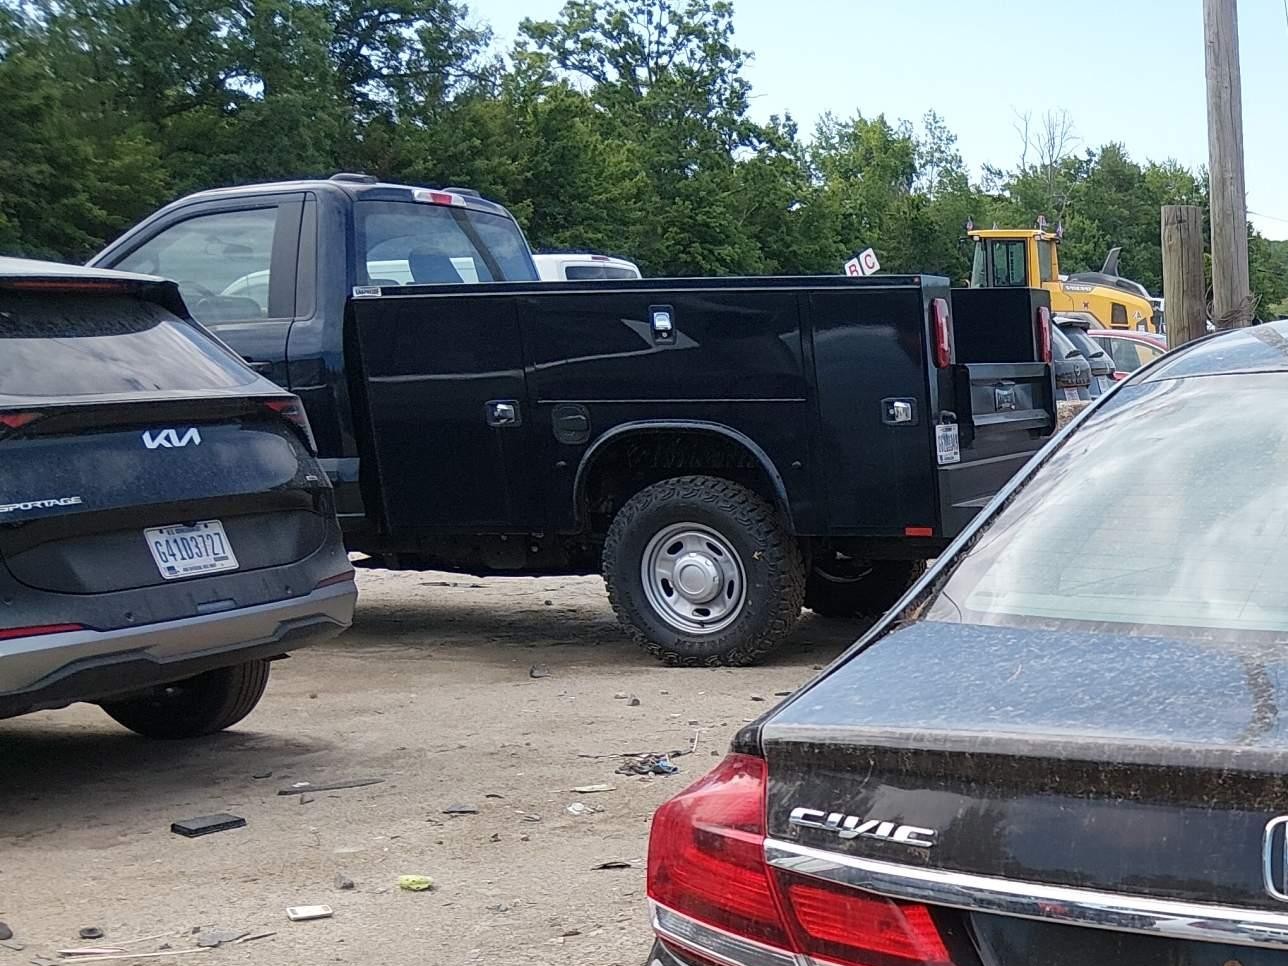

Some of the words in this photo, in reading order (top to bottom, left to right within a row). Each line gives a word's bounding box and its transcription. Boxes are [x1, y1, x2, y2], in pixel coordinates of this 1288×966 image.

[864, 254, 875, 270] C
[142, 427, 202, 449] KIA
[0, 496, 82, 513] SPORTAGE
[789, 807, 938, 848] CIVIC
